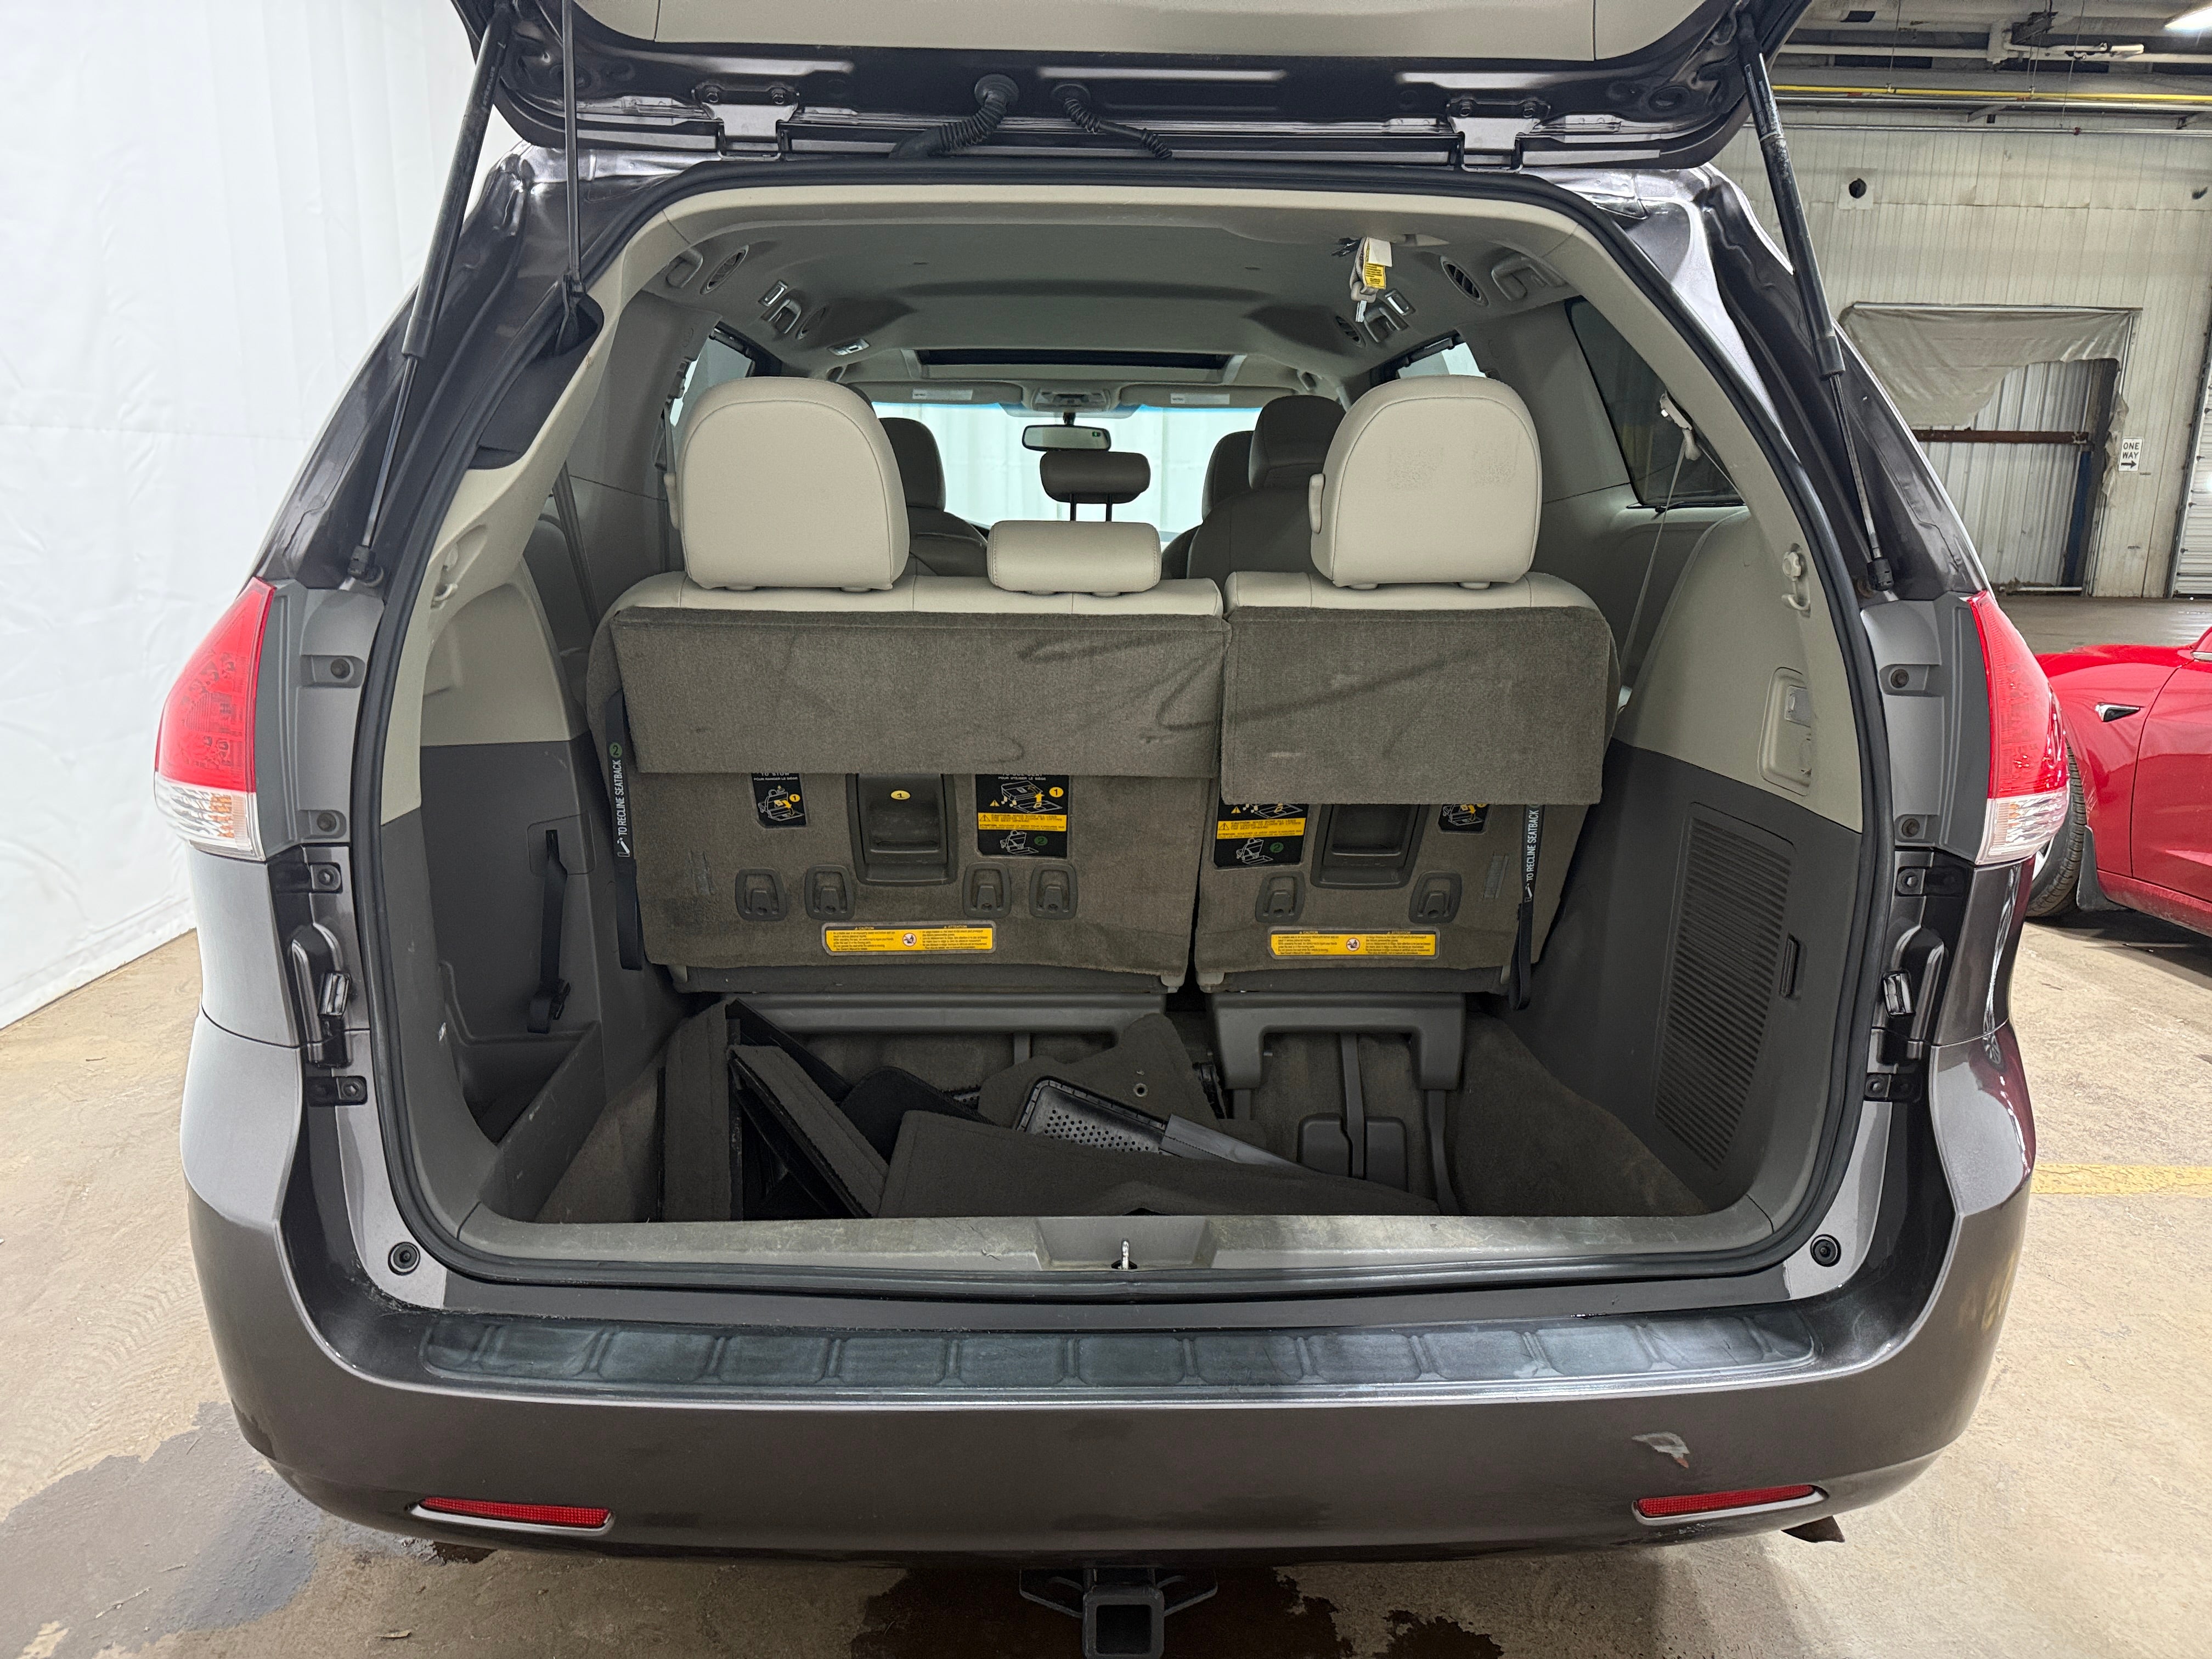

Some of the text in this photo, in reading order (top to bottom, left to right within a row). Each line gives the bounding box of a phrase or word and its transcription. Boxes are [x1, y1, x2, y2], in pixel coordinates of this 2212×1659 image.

[613, 745, 619, 756] 2
[612, 759, 628, 836] TO RECLINE SEATBACK
[1526, 810, 1539, 882] TO RECLINE SEATBACK
